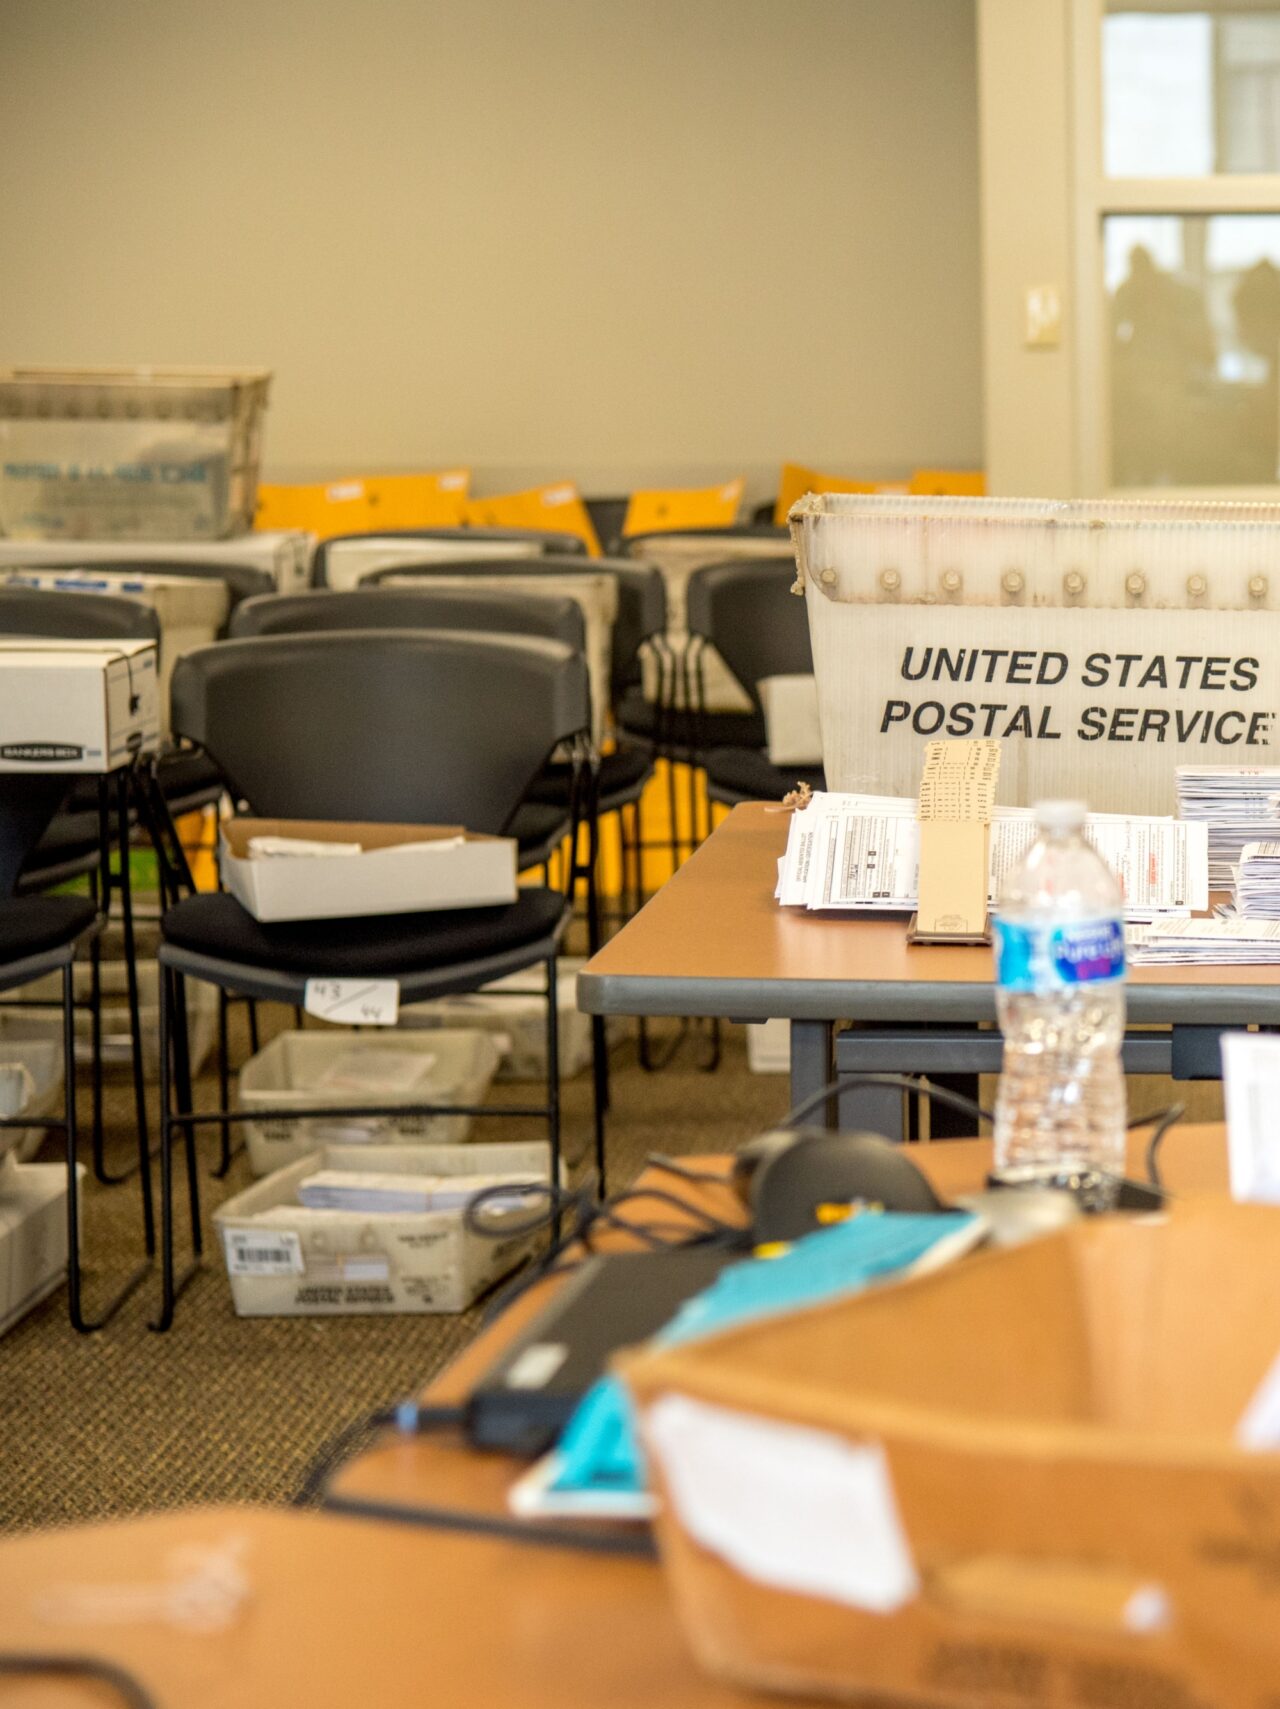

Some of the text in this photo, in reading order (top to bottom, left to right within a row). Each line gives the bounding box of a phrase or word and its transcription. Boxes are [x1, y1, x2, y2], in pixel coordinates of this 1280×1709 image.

[900, 646, 1260, 691] UNITED STATES
[880, 699, 1277, 746] POSTAL SERVICE
